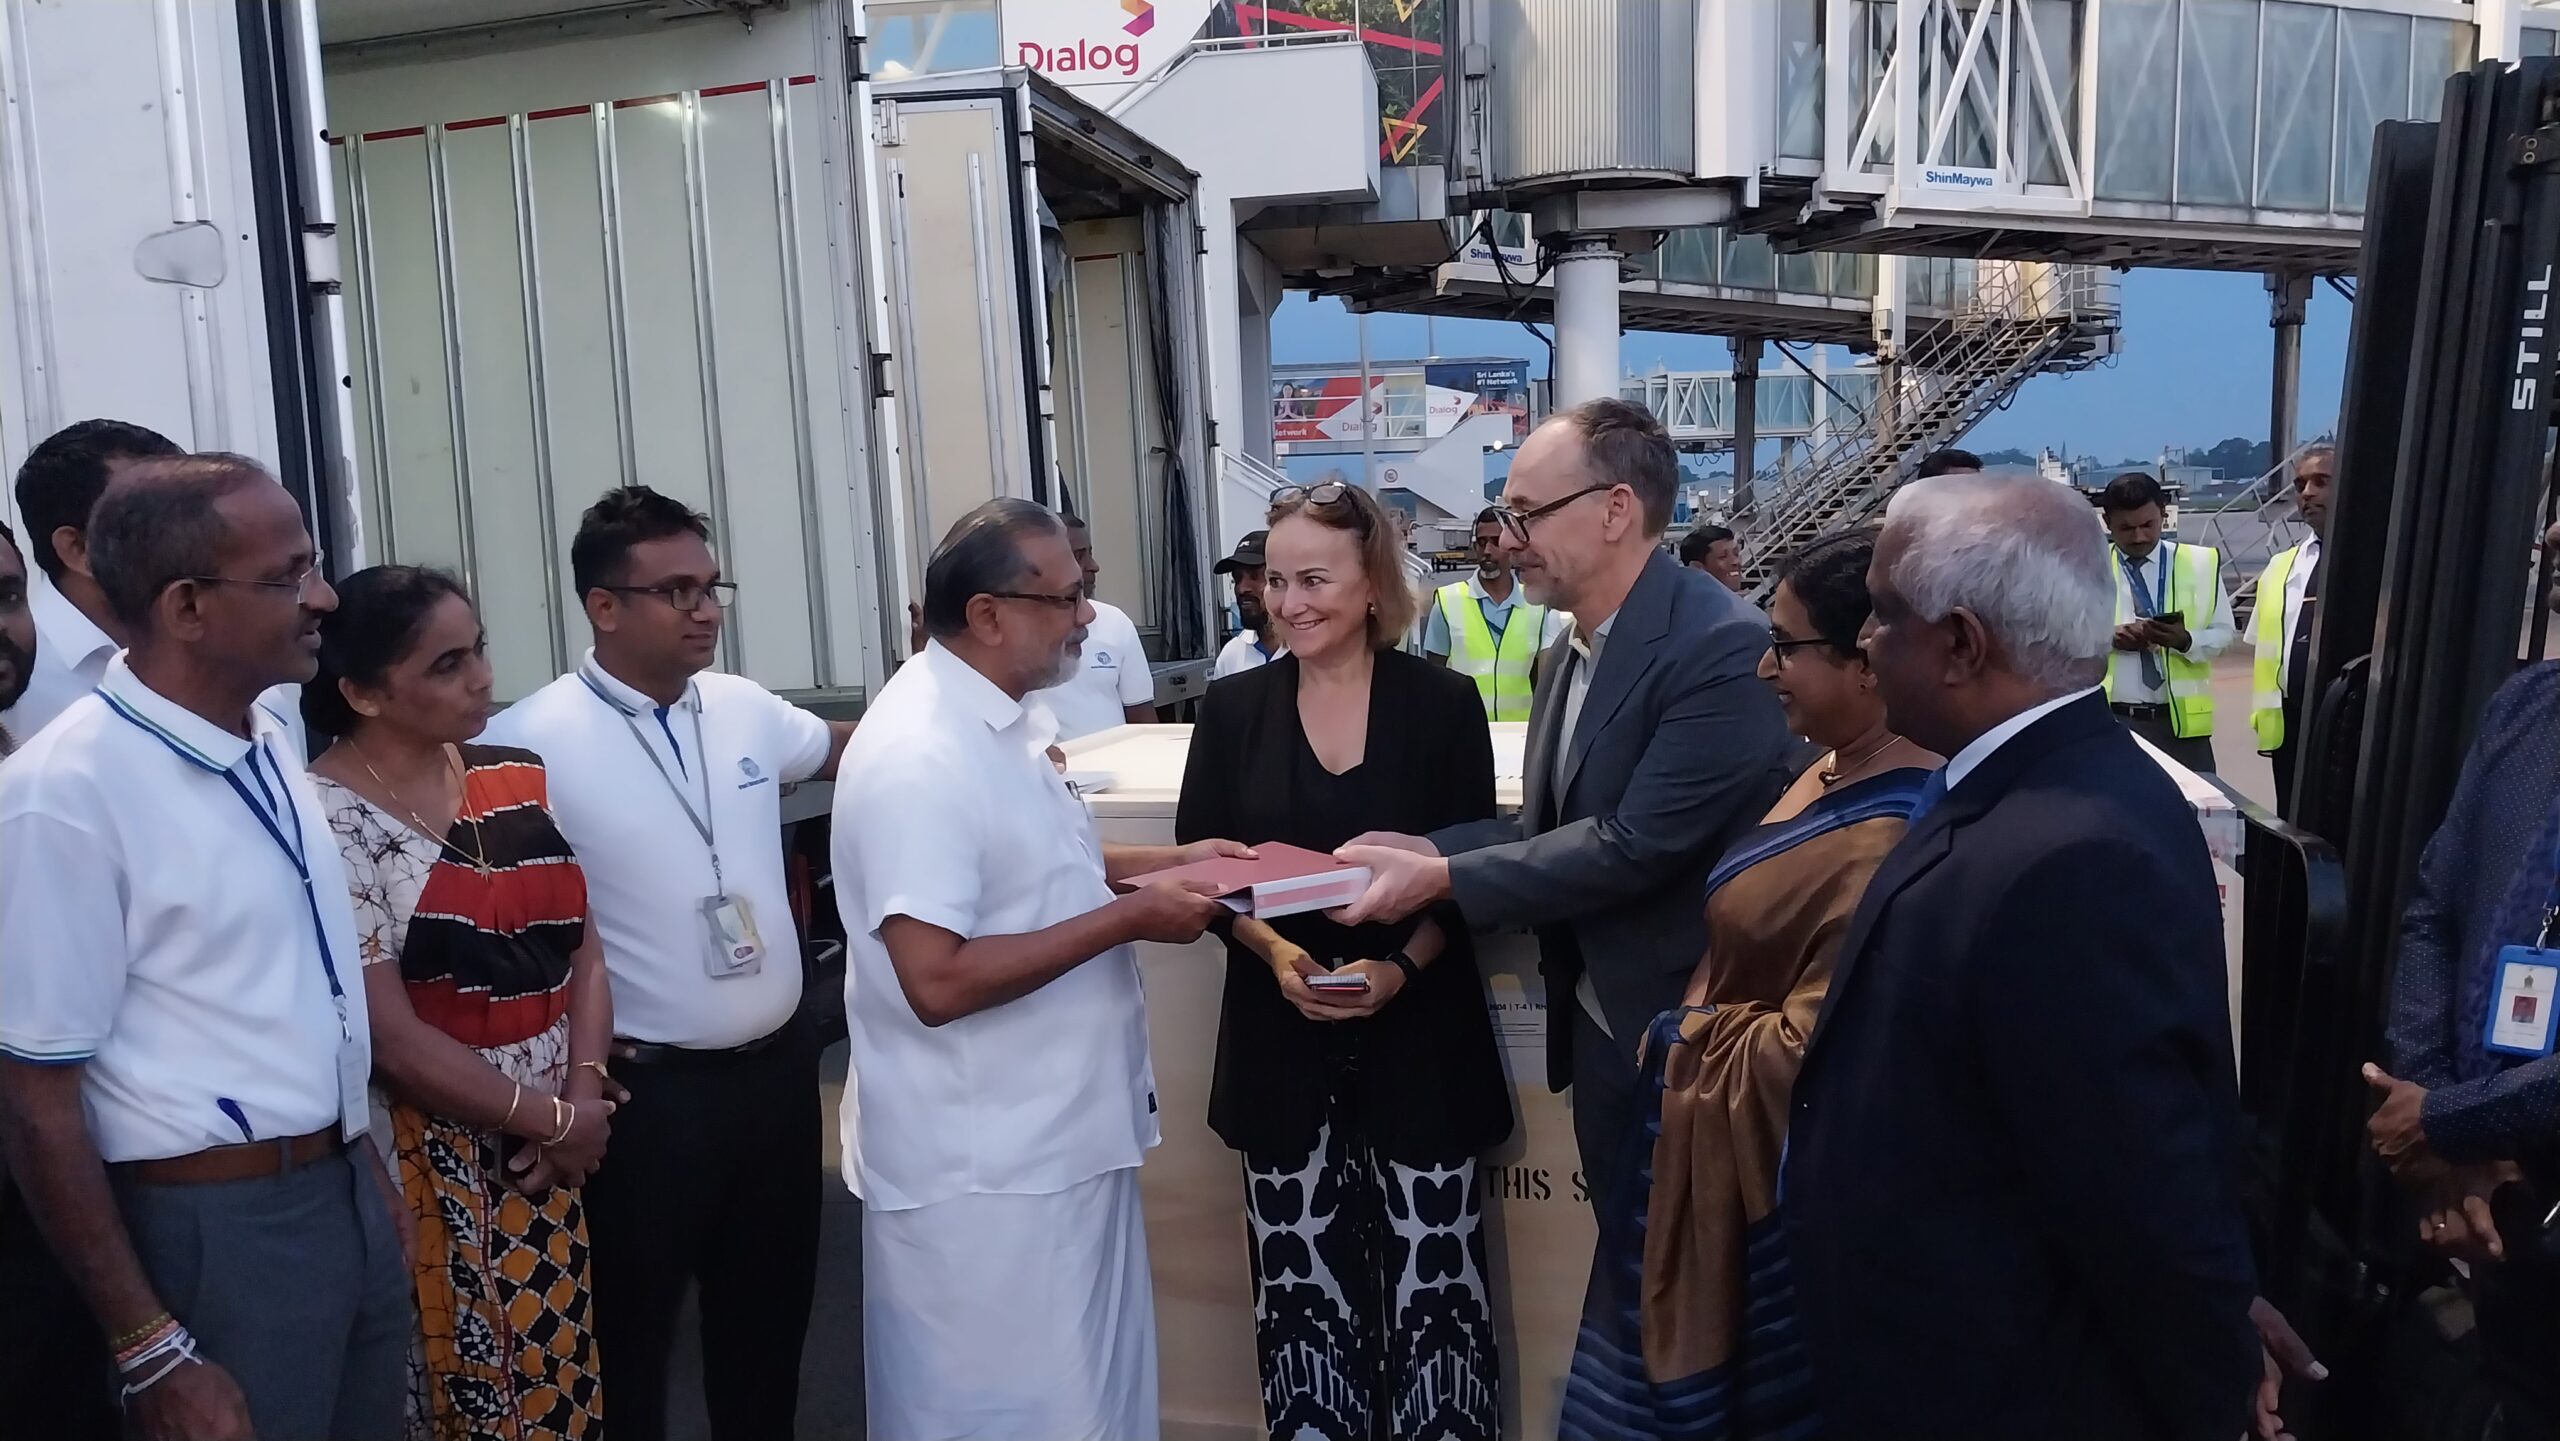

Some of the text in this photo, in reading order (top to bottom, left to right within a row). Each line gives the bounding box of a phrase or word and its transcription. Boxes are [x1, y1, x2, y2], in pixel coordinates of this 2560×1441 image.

[1018, 38, 1139, 76] Dialog
[1926, 171, 1993, 187] ShinMaywa
[1470, 248, 1522, 263] Shinaywa
[2511, 264, 2552, 410] STILL
[1429, 406, 1458, 415] Dialog
[1342, 422, 1378, 432] Dialg
[1484, 1166, 1551, 1201] THIS
